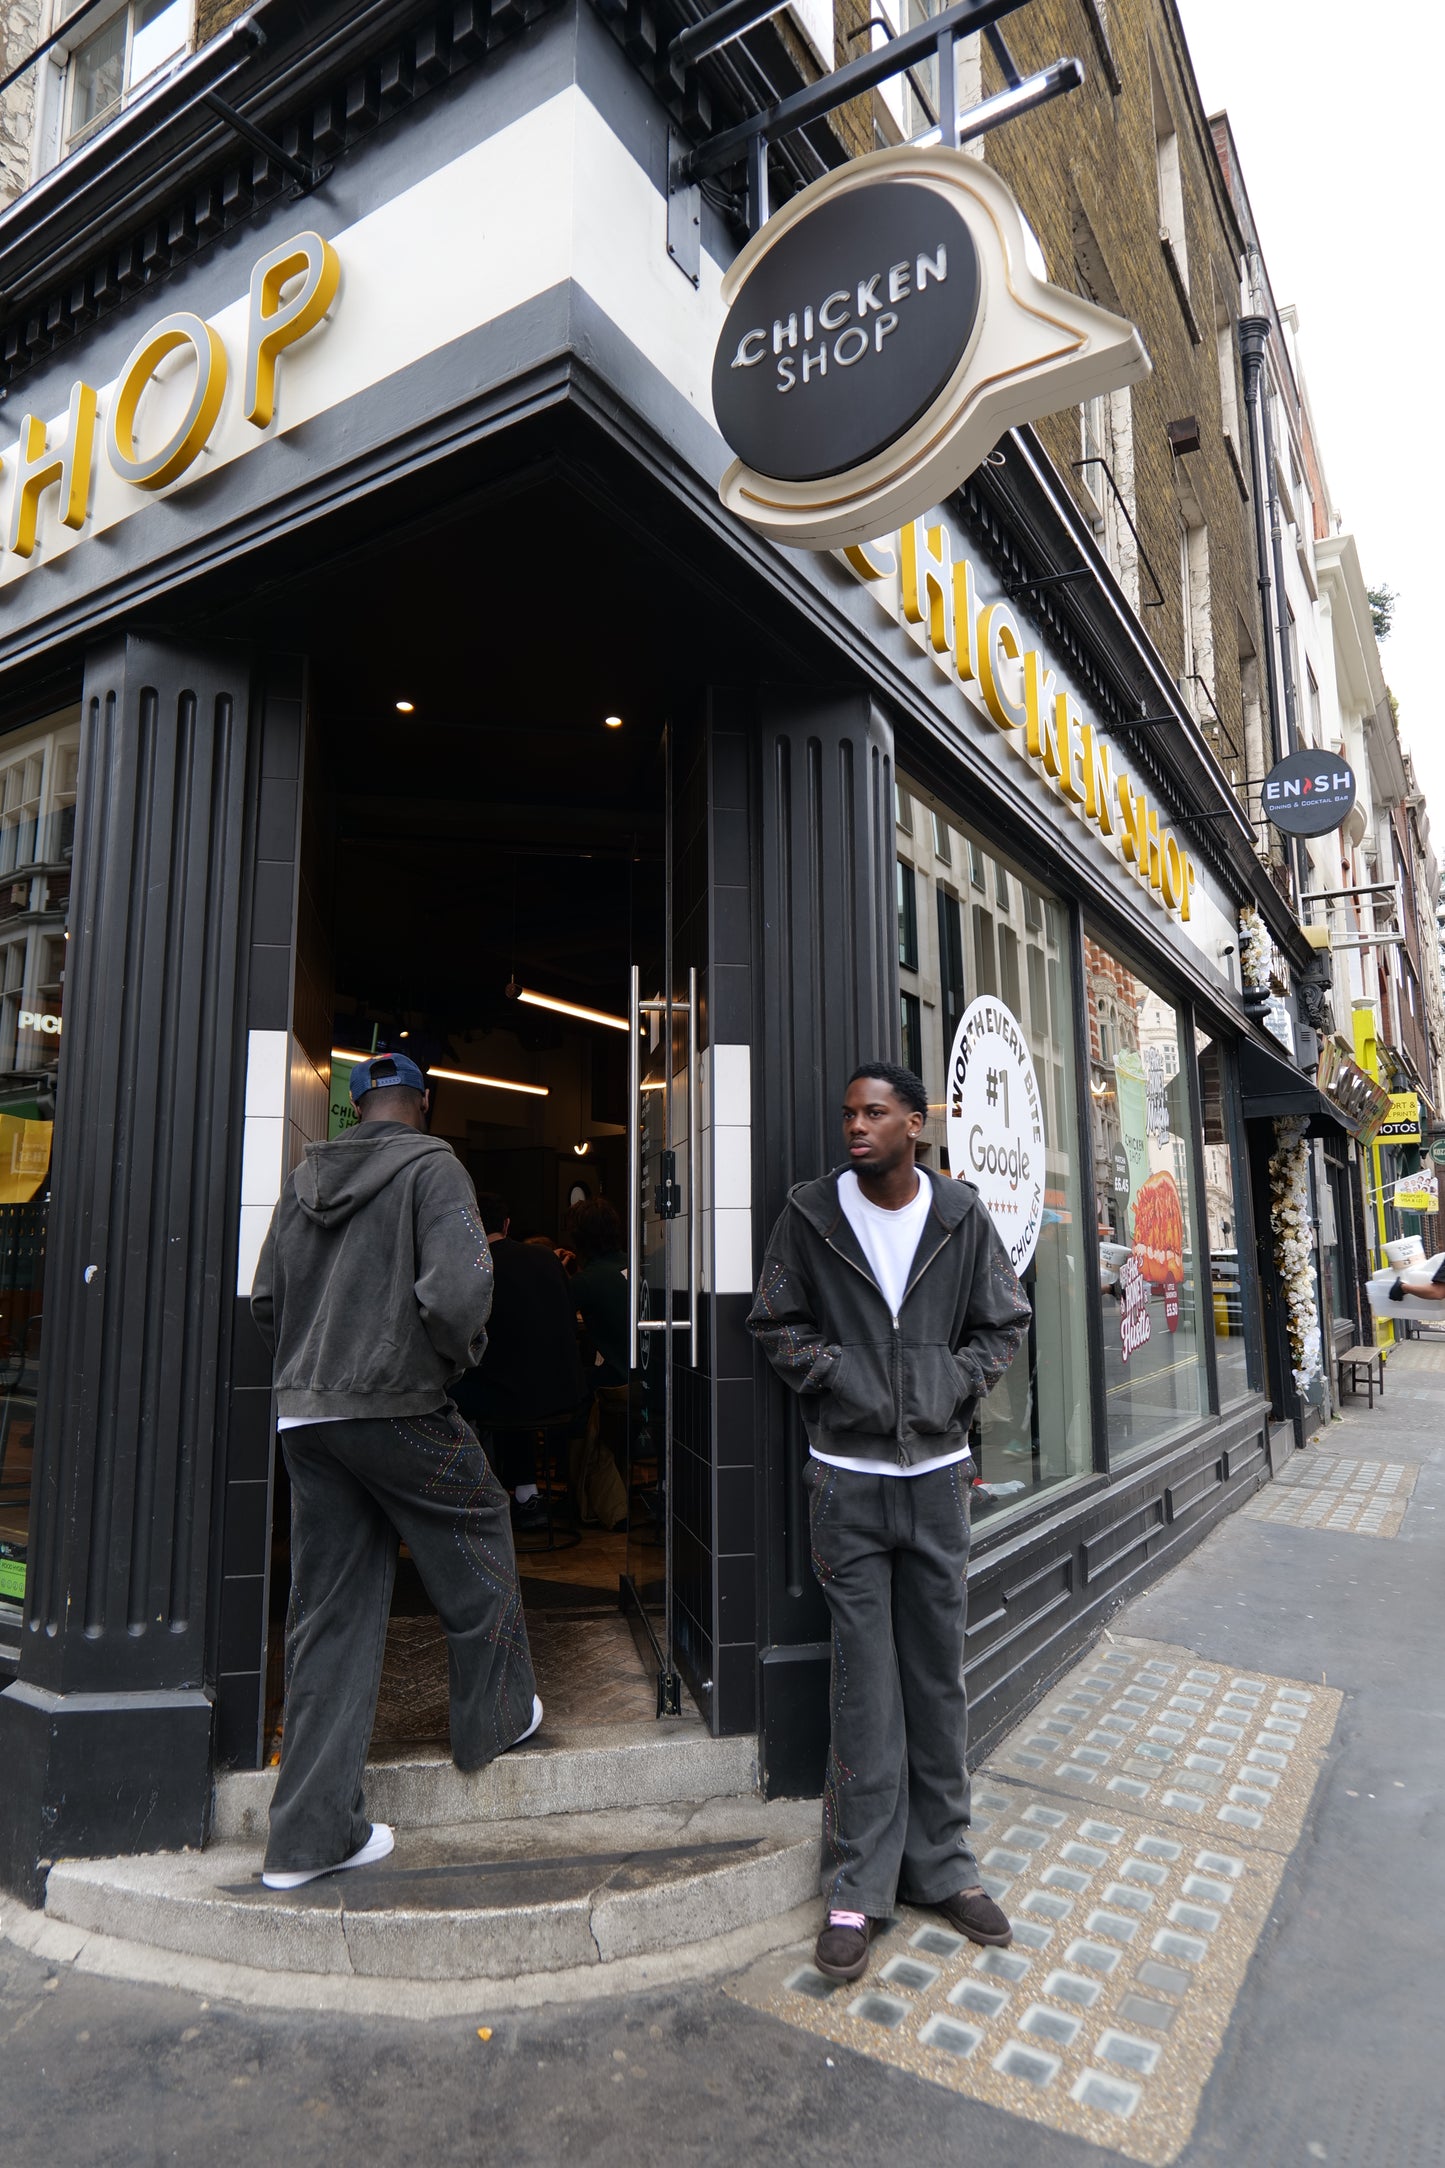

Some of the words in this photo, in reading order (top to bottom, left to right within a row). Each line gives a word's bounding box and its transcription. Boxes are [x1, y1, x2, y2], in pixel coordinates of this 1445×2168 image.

[731, 243, 948, 368] CHICKEN
[776, 312, 899, 393] SHOP
[0, 231, 340, 559] HOP
[1117, 773, 1196, 923] SHOP
[951, 1010, 985, 1118] WORTH
[986, 1008, 1026, 1067] EVERY
[1024, 1070, 1042, 1144] BITE
[986, 1067, 1010, 1129] #1
[1409, 1101, 1416, 1109] &
[331, 1103, 358, 1120] CHIC
[1379, 1123, 1417, 1134] HOTOS
[1392, 1110, 1417, 1118] PRINTS
[969, 1123, 1031, 1191] Google
[1010, 1181, 1041, 1267] CHICKEN
[1120, 1308, 1150, 1362] Hustle
